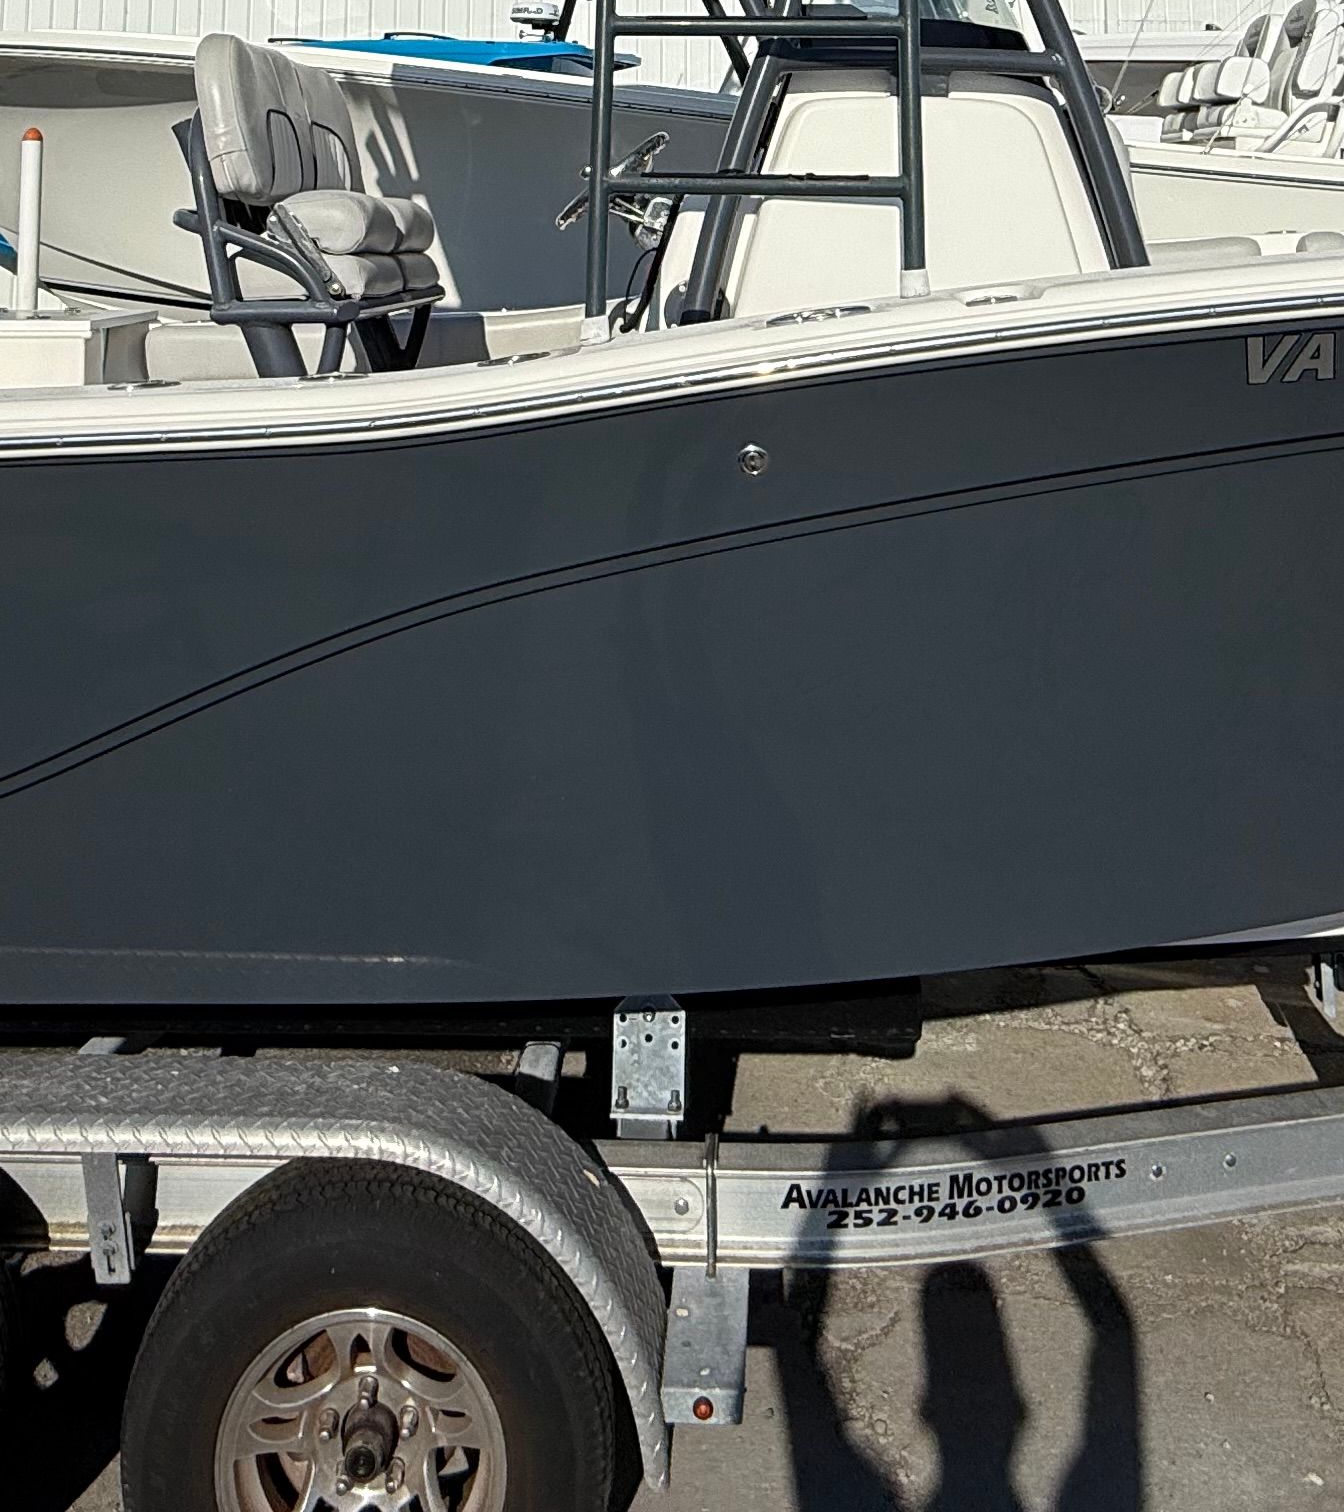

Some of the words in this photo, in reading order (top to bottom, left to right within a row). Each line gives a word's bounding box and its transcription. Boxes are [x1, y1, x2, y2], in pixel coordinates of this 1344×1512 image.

[1245, 332, 1336, 384] VA
[781, 1183, 940, 1209] AVALANCHE
[948, 1158, 1127, 1200] MOTORSPORTS
[826, 1186, 1086, 1230] 252-946-0920
